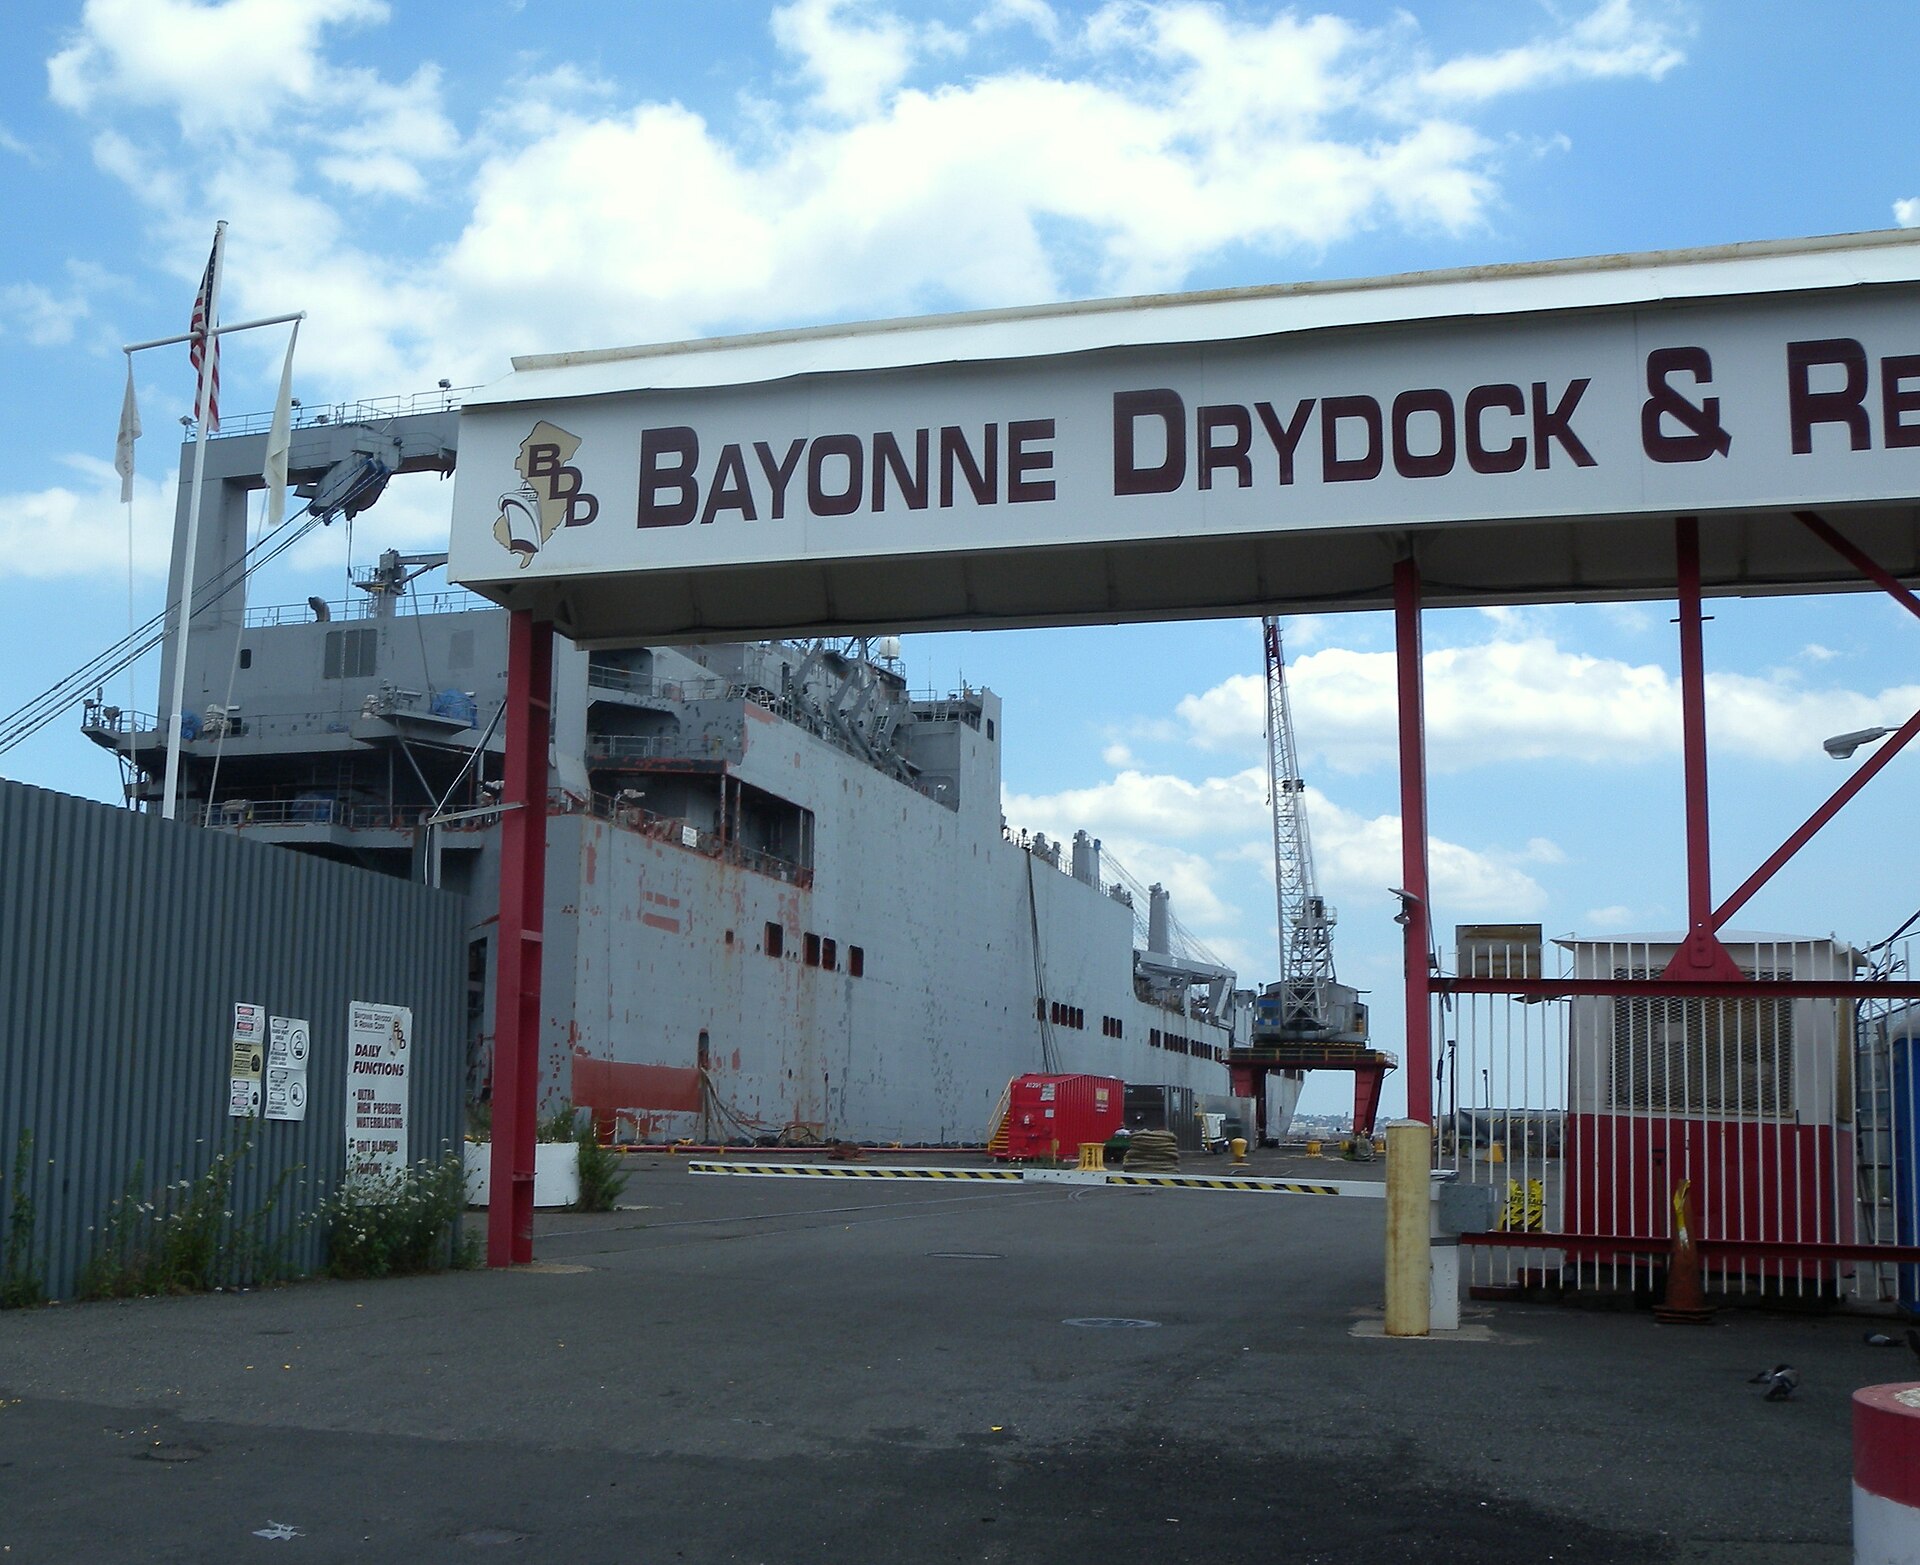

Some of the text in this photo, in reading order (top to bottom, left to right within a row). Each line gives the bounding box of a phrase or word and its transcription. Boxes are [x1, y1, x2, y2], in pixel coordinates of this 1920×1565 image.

[637, 417, 1056, 529] BAYONNE
[1113, 377, 1598, 496] DRYDOCK
[1641, 346, 1732, 464] &
[527, 443, 600, 528] BDD
[353, 1060, 405, 1077] FUNCTIONS
[355, 1043, 382, 1058] DAILY
